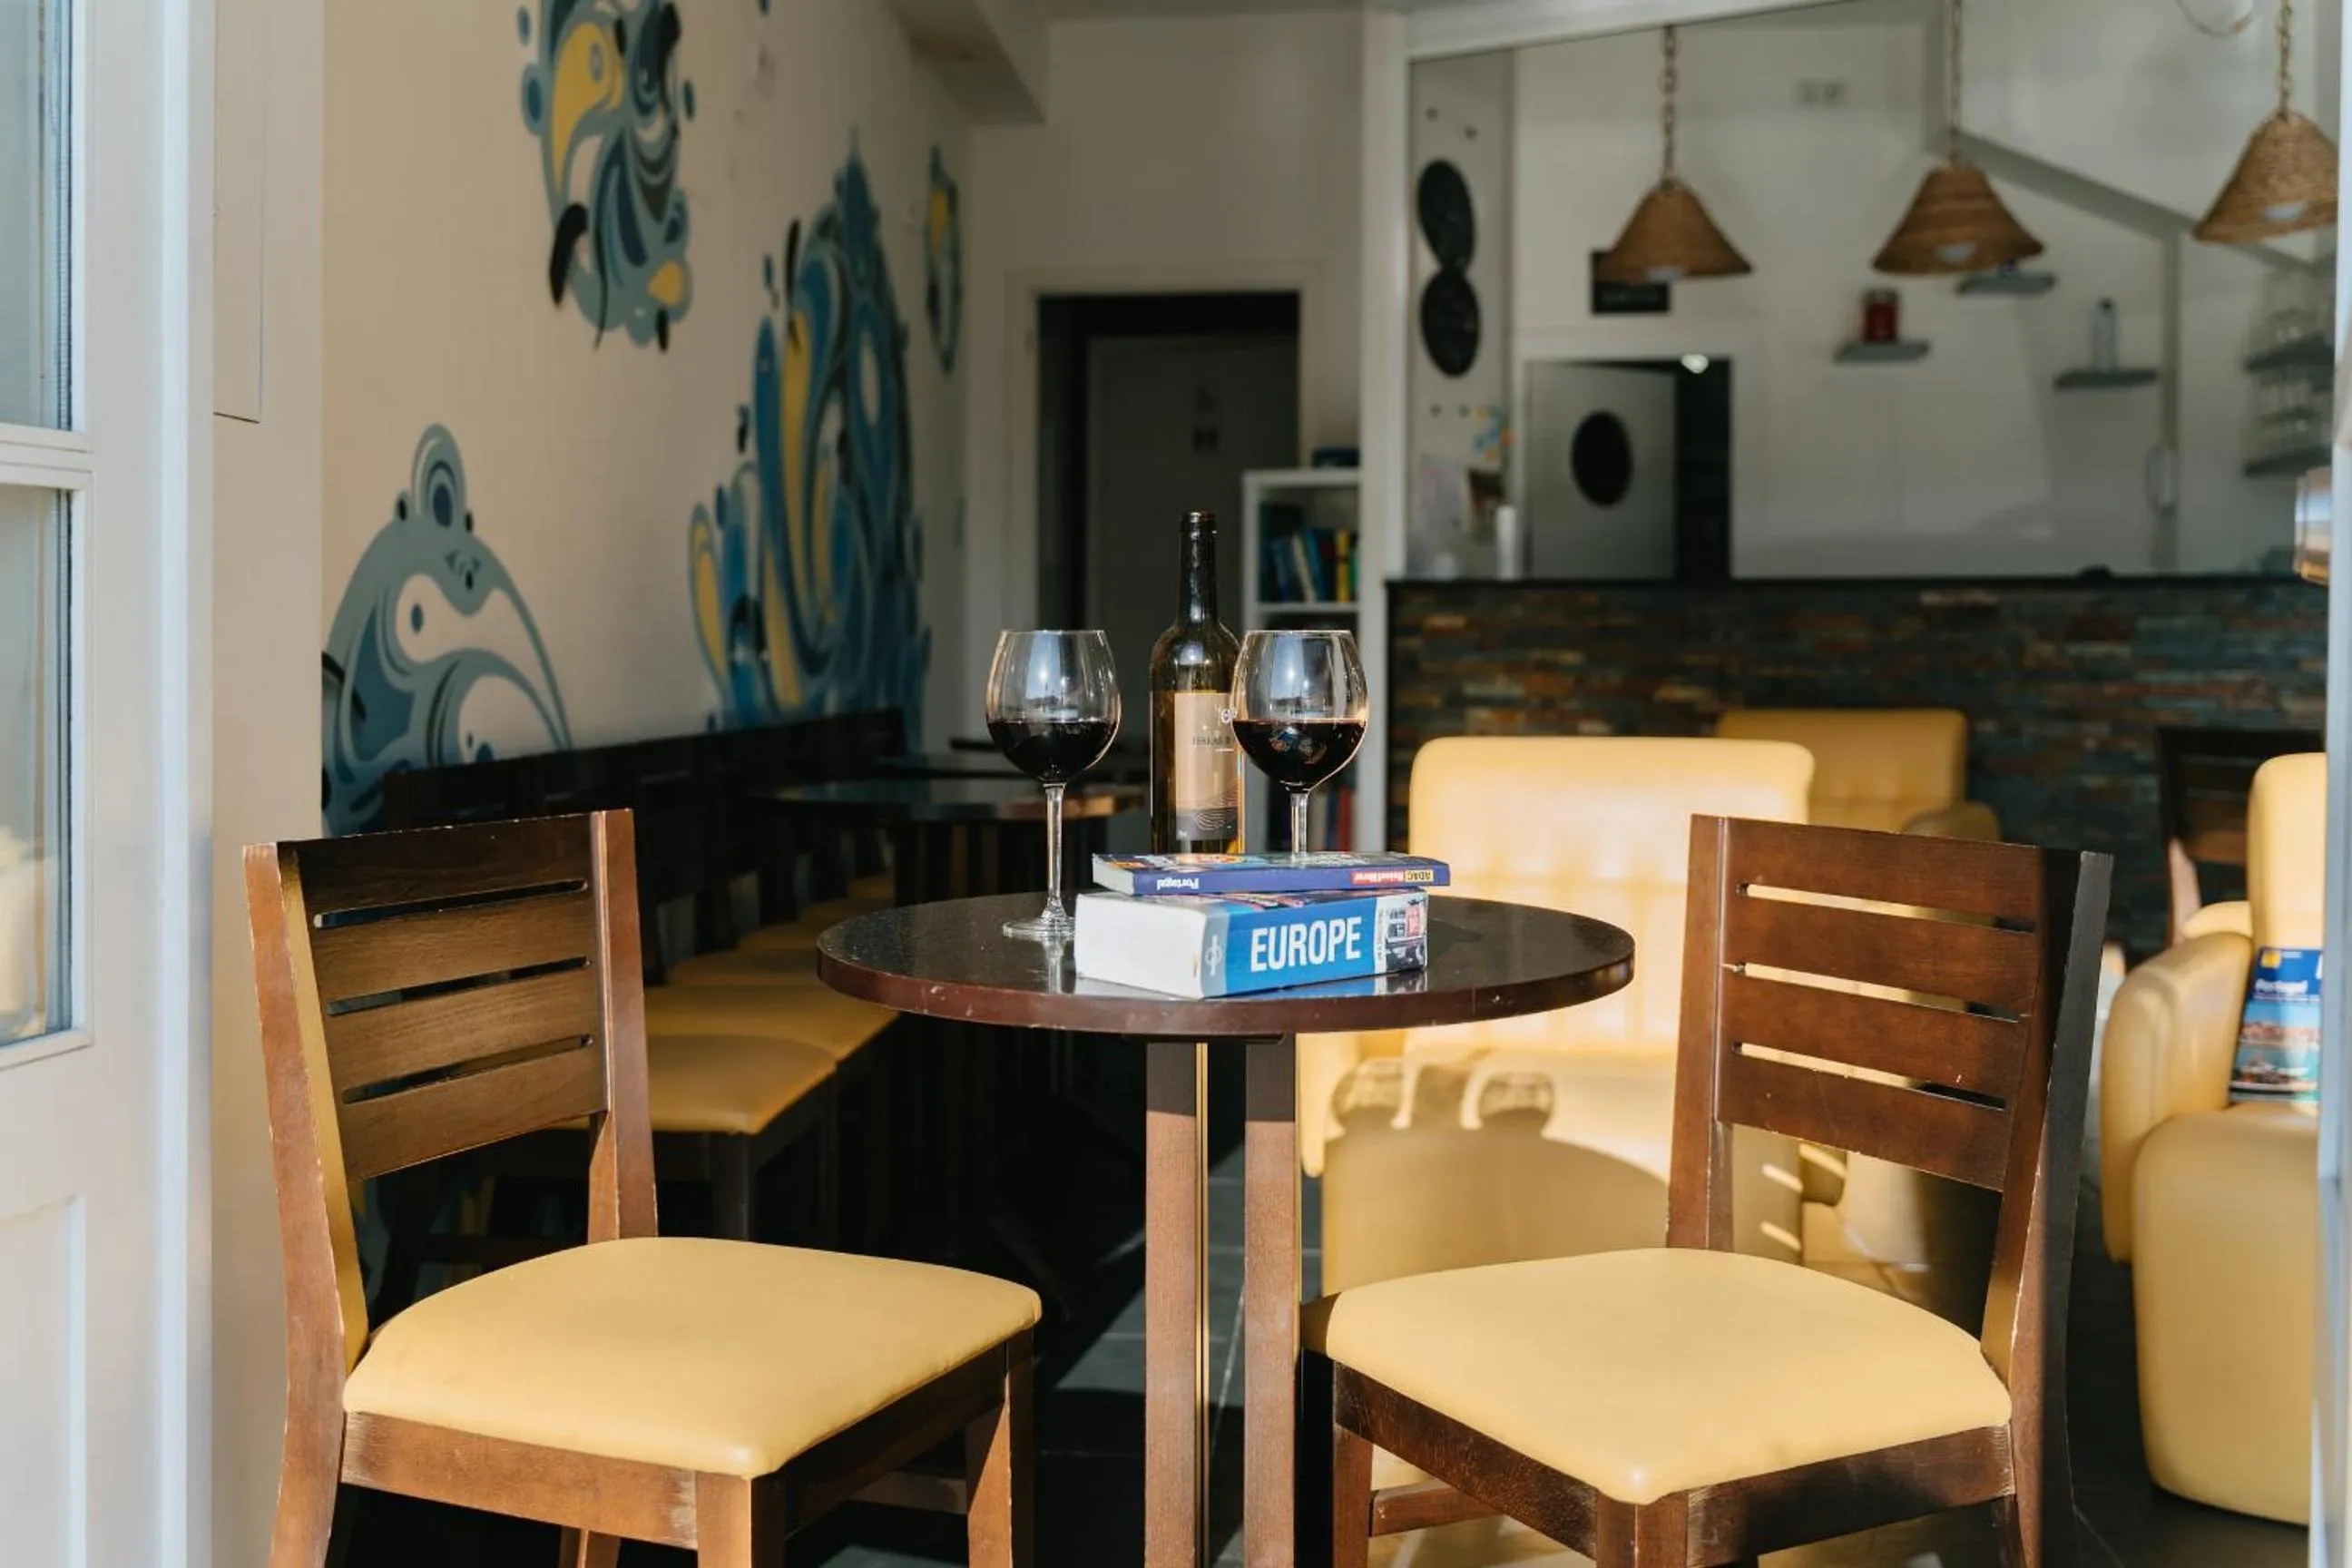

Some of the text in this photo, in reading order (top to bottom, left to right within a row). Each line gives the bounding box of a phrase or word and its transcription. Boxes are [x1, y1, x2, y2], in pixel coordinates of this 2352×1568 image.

[1406, 871, 1431, 880] ADAC
[1156, 877, 1200, 891] Portugal
[1250, 916, 1362, 973] EUROPE
